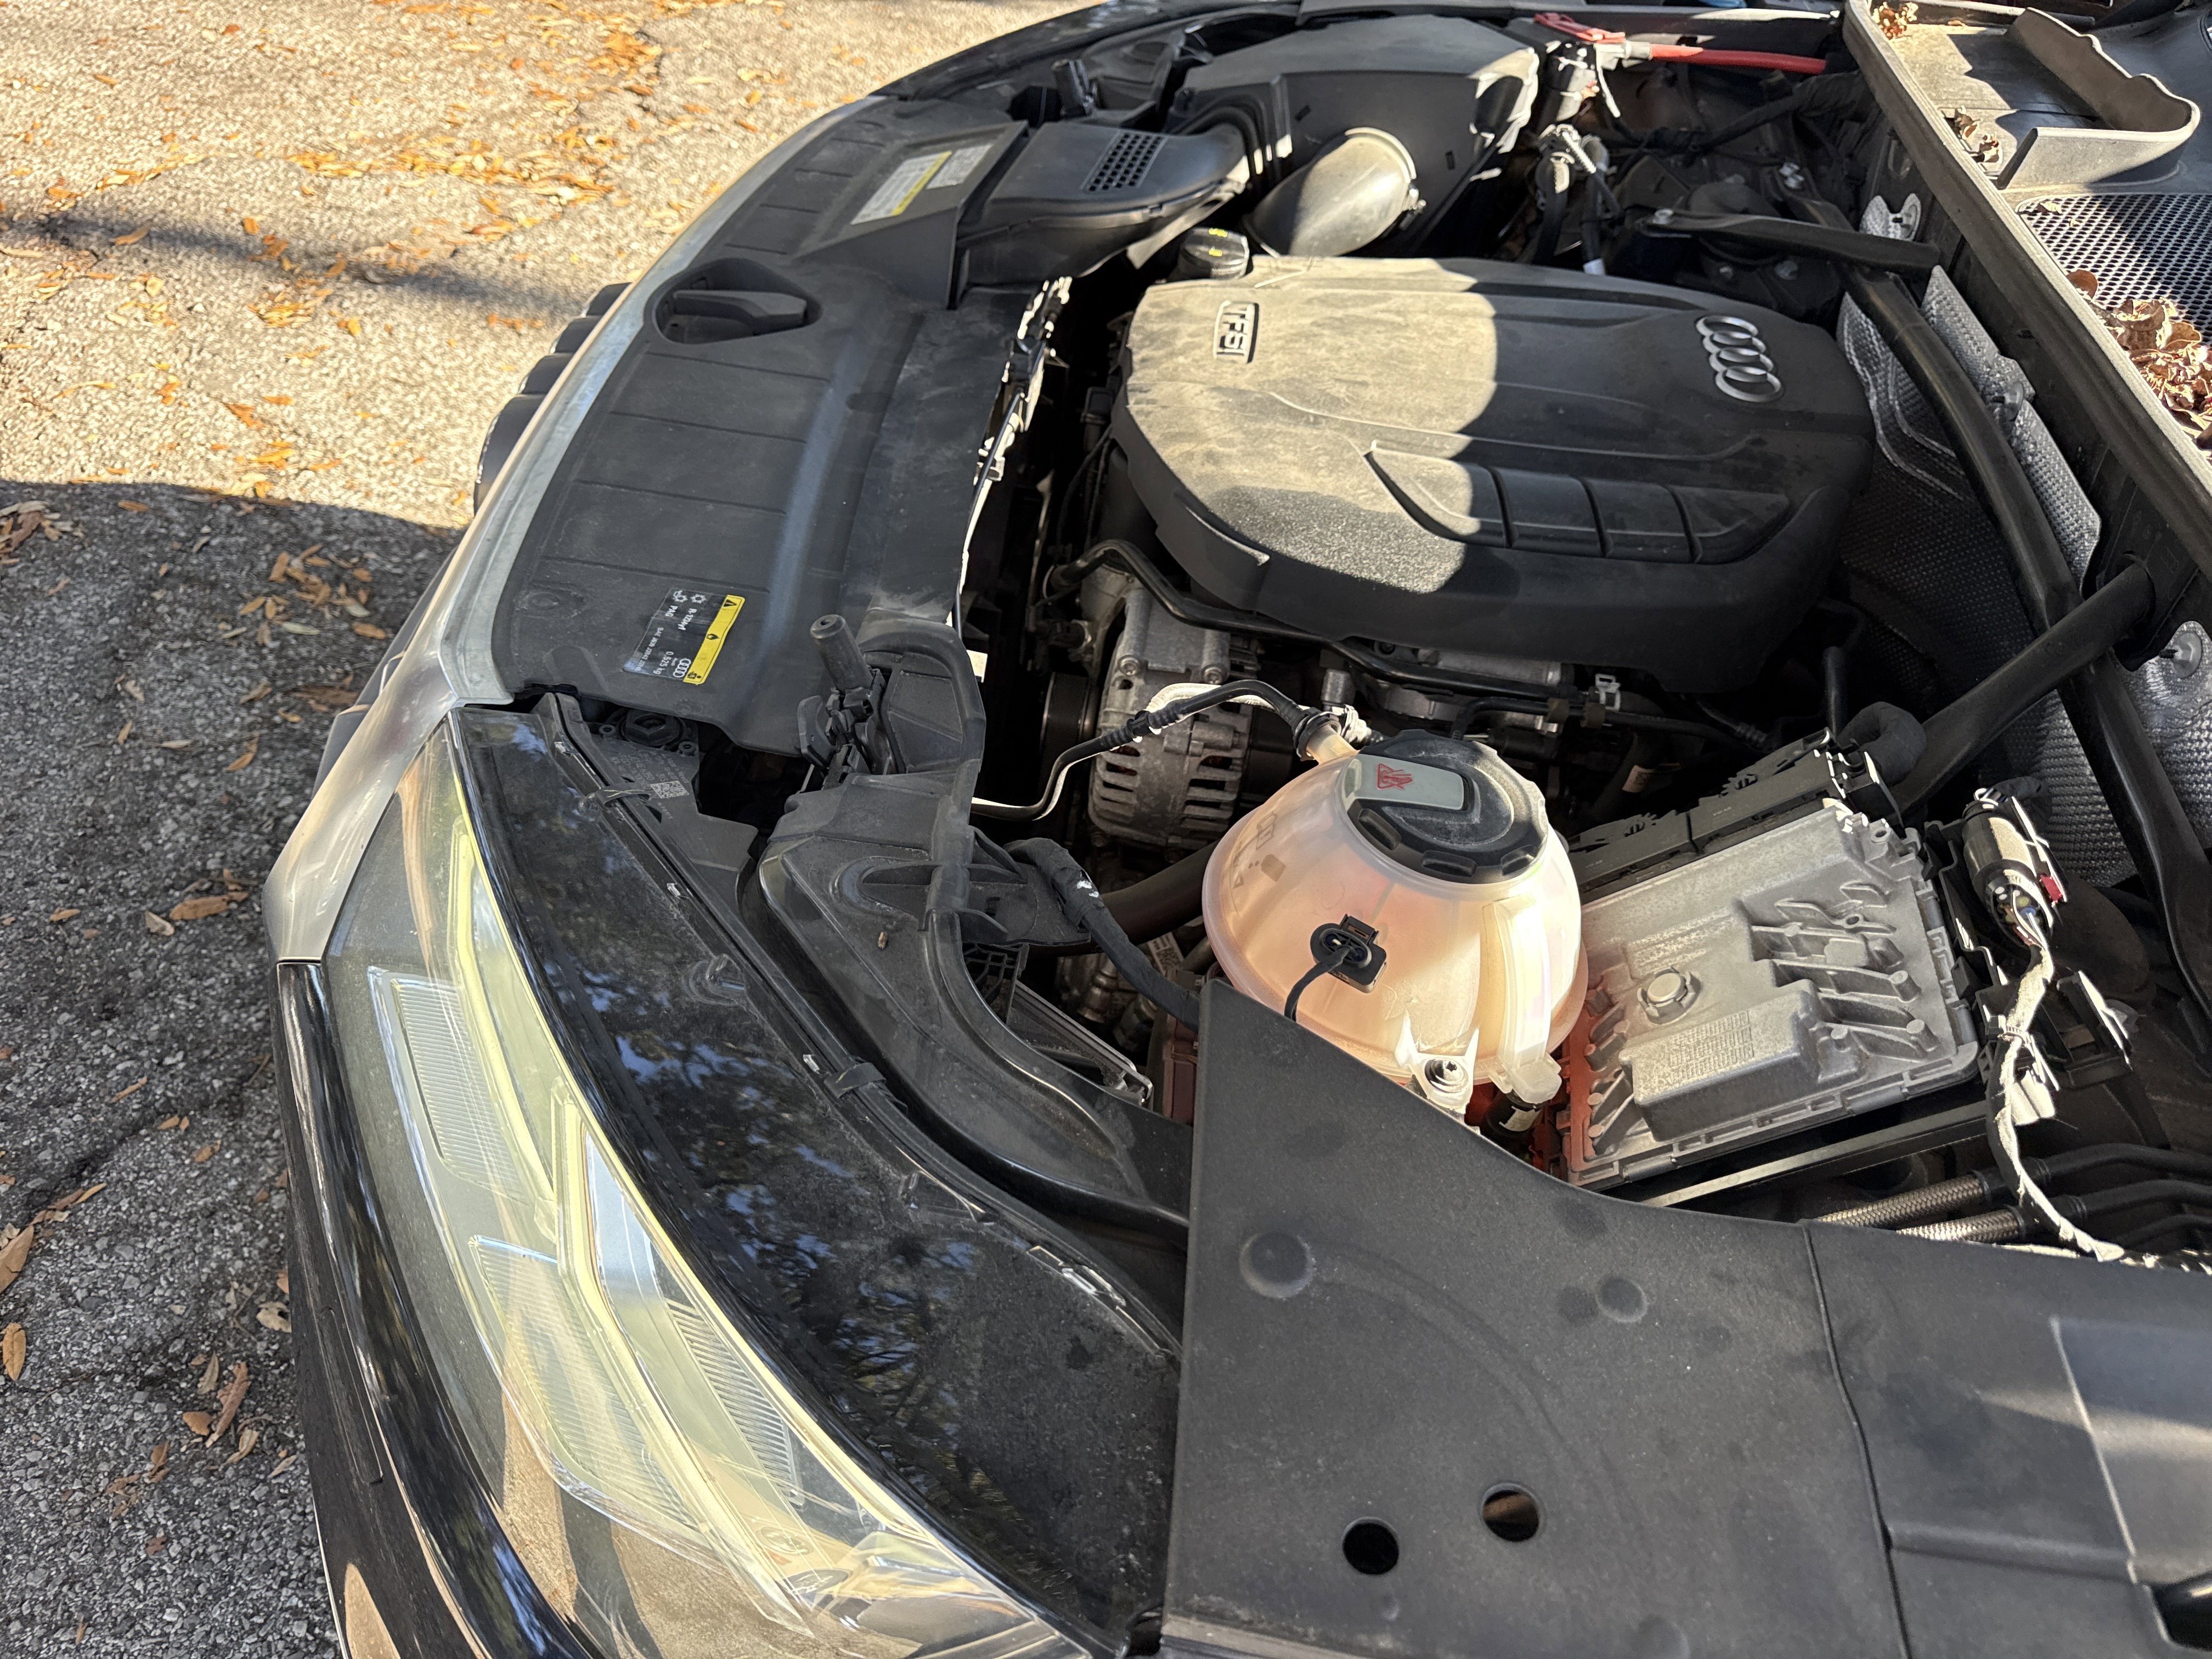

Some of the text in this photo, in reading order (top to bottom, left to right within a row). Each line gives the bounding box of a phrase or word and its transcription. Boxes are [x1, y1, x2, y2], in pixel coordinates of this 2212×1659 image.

[1216, 306, 1251, 356] TFSI
[664, 605, 678, 617] PAG
[677, 608, 697, 630] R-1234yf
[654, 627, 664, 637] SAE
